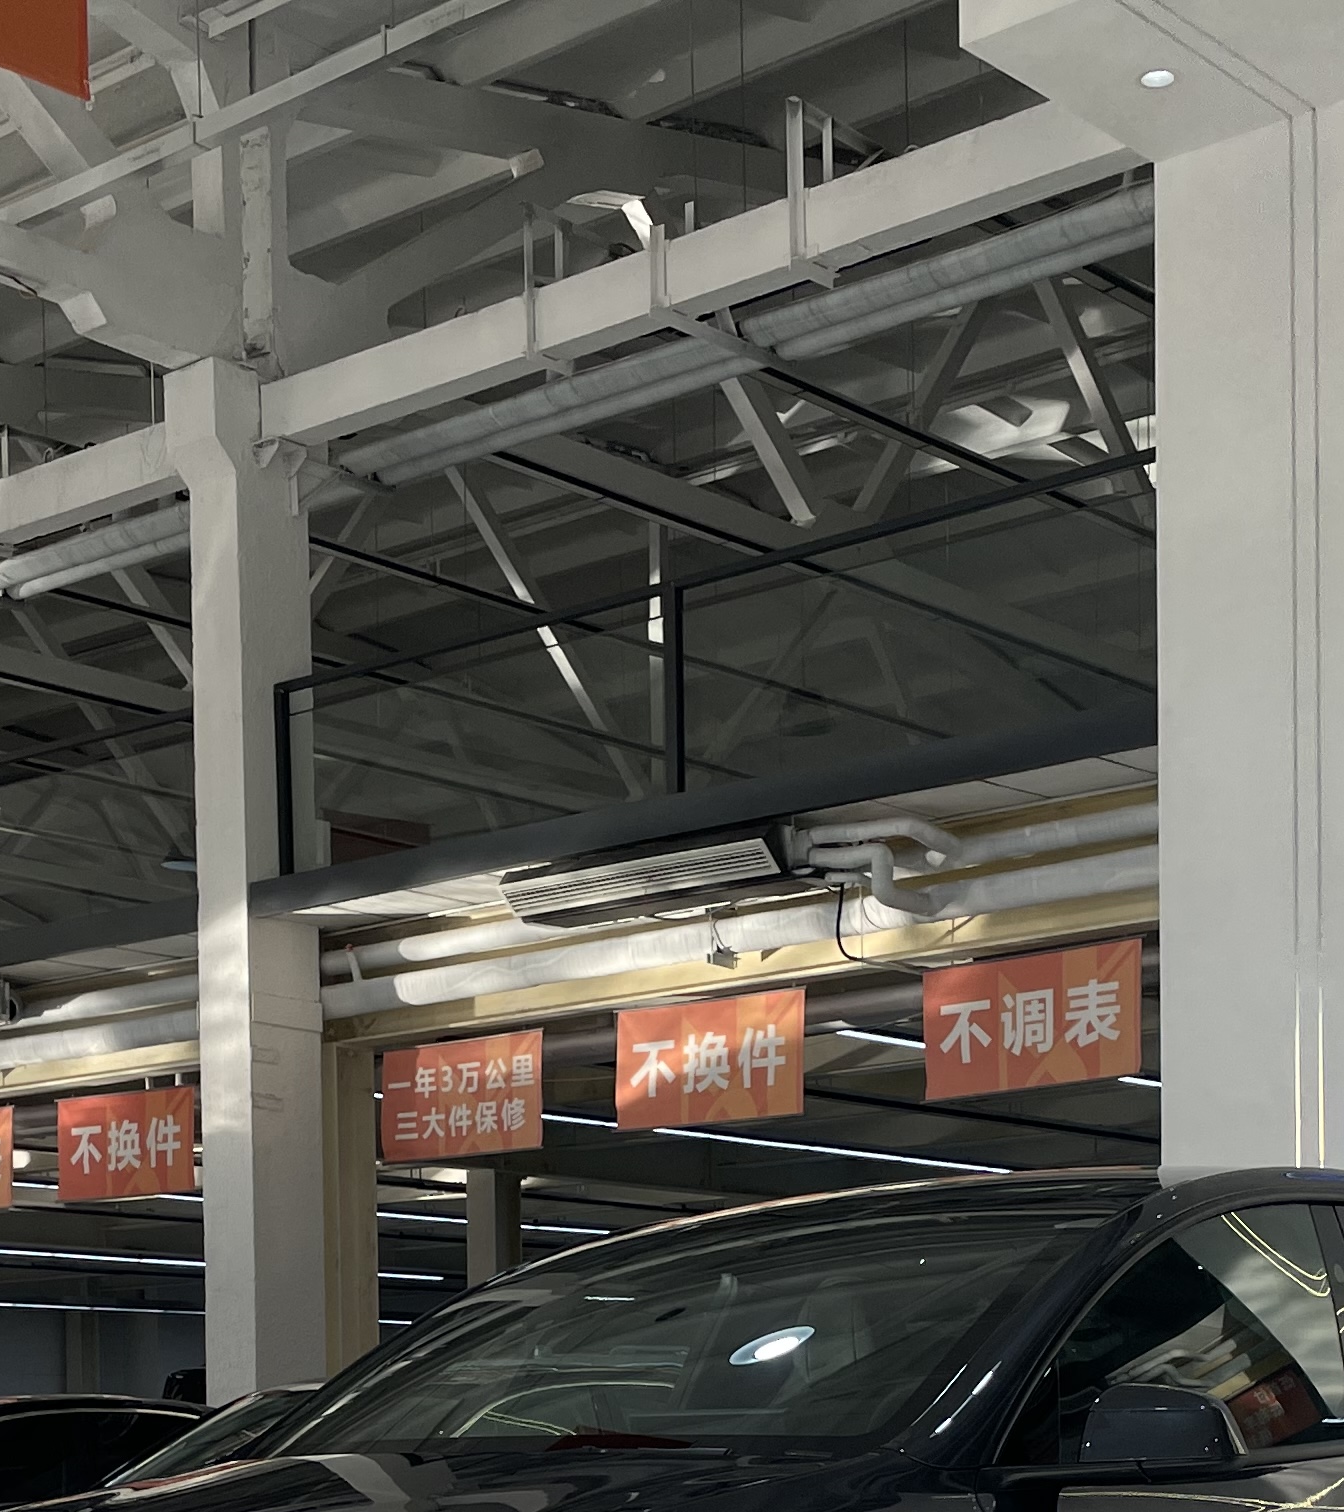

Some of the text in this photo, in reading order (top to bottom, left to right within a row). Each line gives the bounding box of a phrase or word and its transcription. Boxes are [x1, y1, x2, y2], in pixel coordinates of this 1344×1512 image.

[940, 979, 1122, 1064] 不调表
[388, 1052, 536, 1100] 一年3万公里
[630, 1024, 787, 1098] 不换件
[70, 1116, 181, 1175] 不换件
[395, 1099, 528, 1142] 三大件保修
